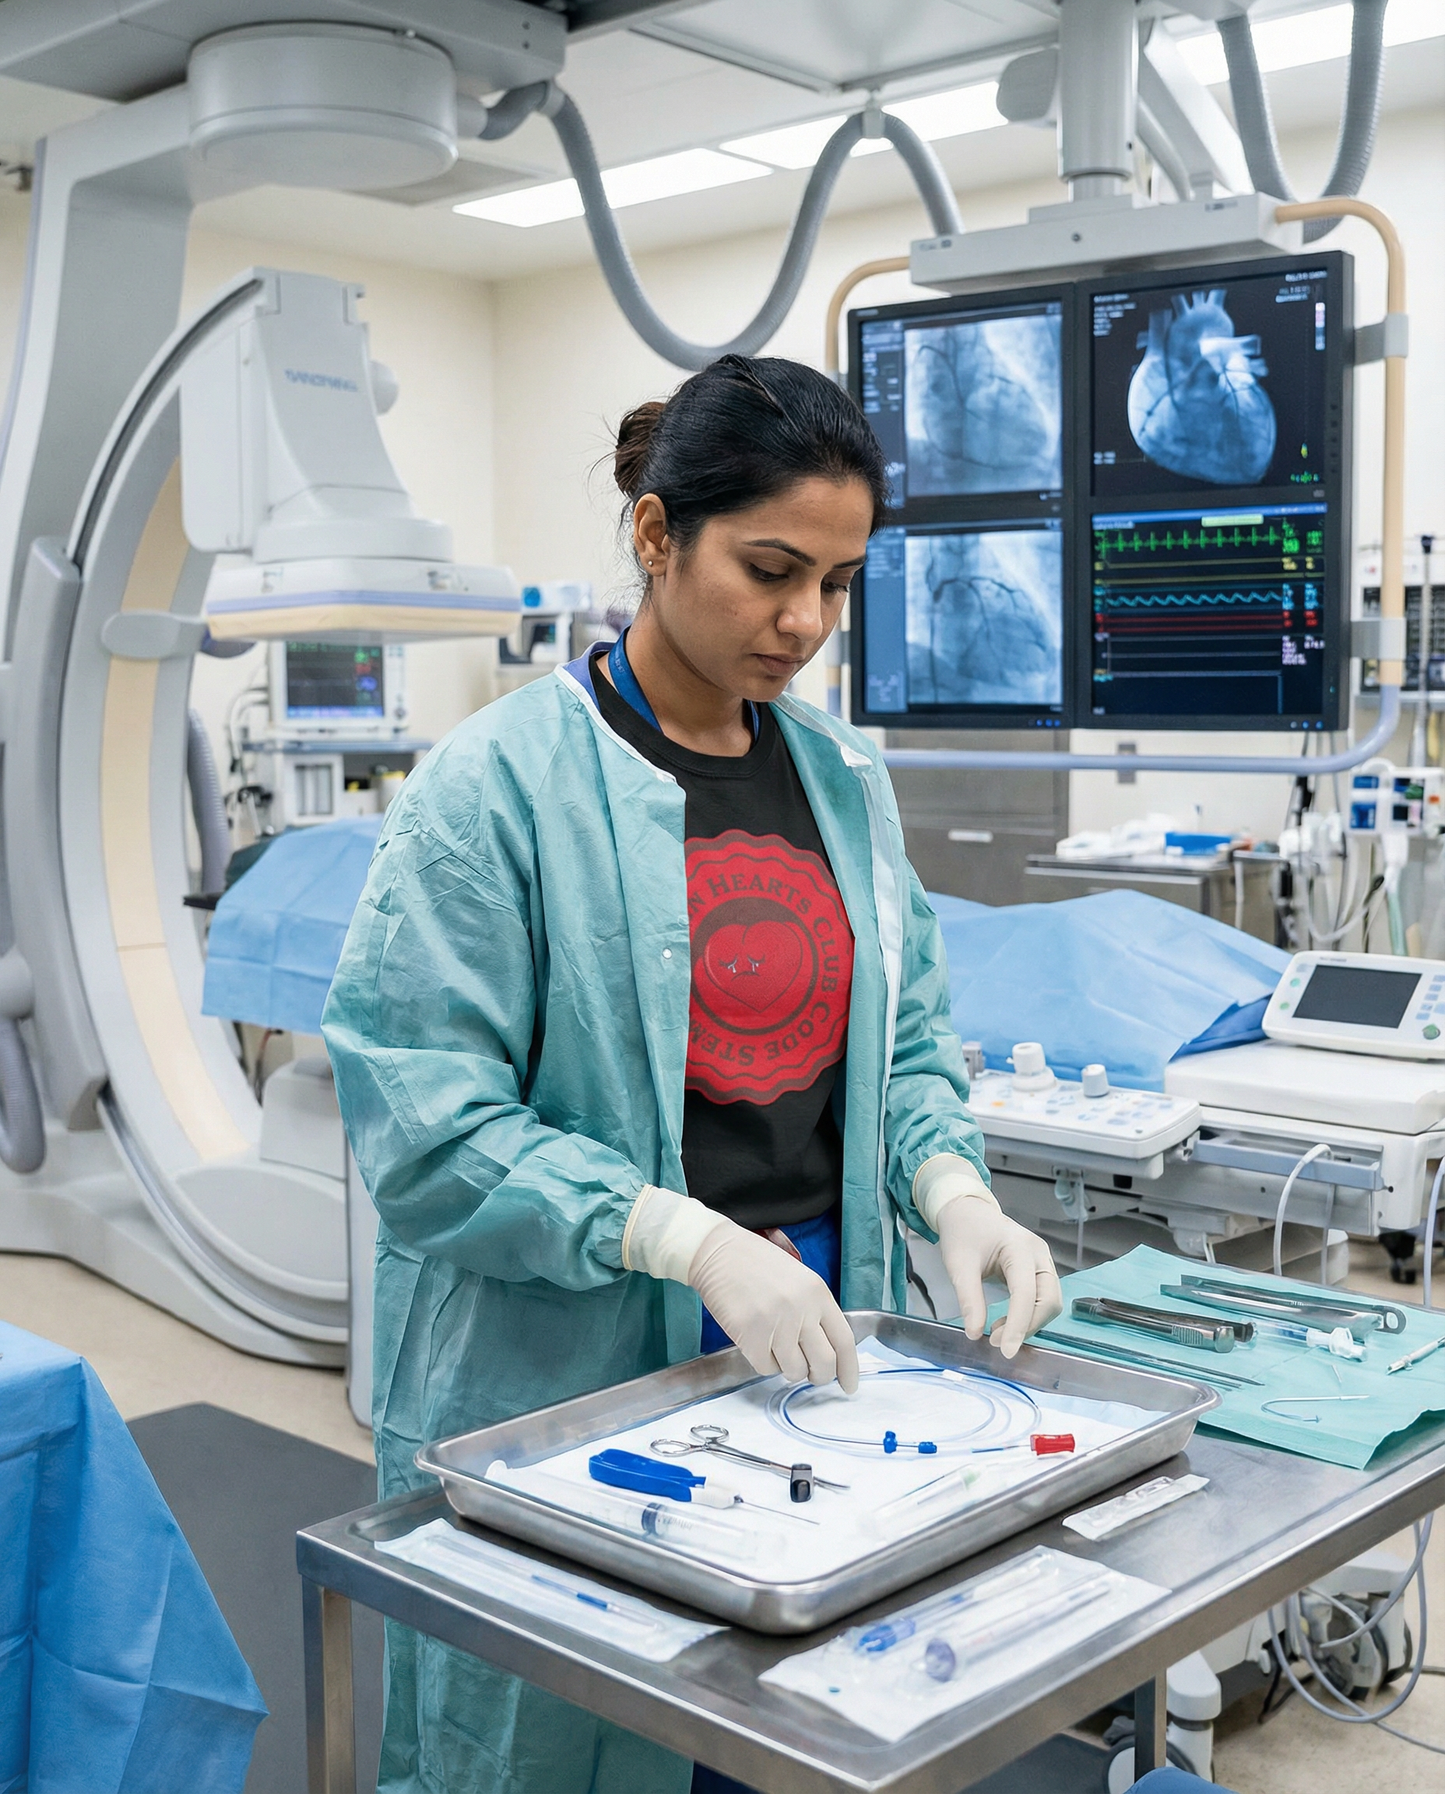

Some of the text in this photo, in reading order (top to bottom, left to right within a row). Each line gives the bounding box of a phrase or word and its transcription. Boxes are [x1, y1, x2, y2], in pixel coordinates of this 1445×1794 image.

[706, 873, 812, 915] HEARTS
[812, 916, 840, 993] CLUB
[763, 1000, 830, 1061] CODE
